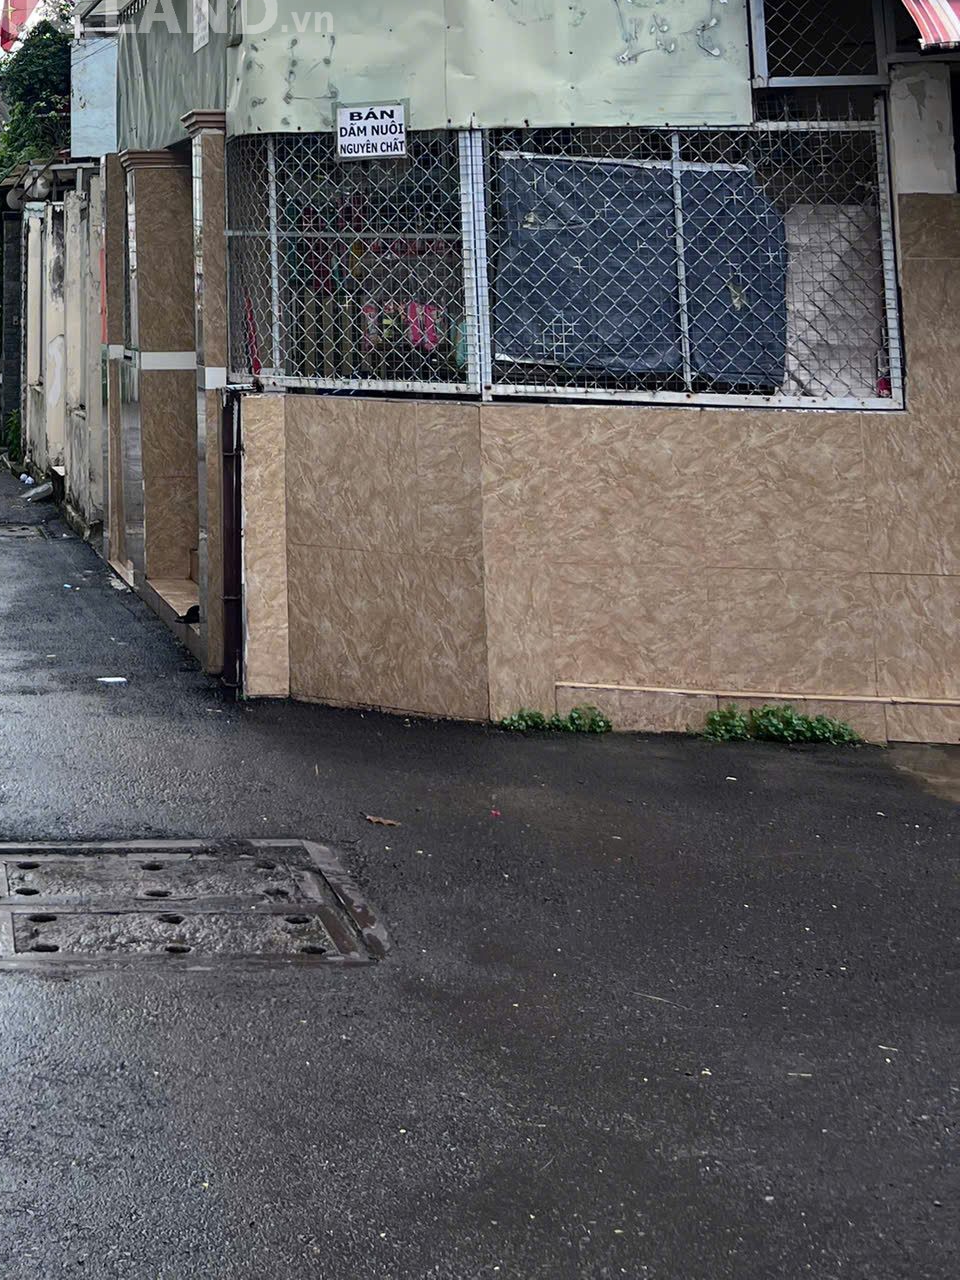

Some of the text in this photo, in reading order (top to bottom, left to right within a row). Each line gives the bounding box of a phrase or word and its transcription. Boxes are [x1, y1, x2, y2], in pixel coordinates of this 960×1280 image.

[349, 108, 394, 121] BÁN
[371, 120, 404, 136] NUÔI
[340, 137, 405, 154] NGUYÊN CHẤT
